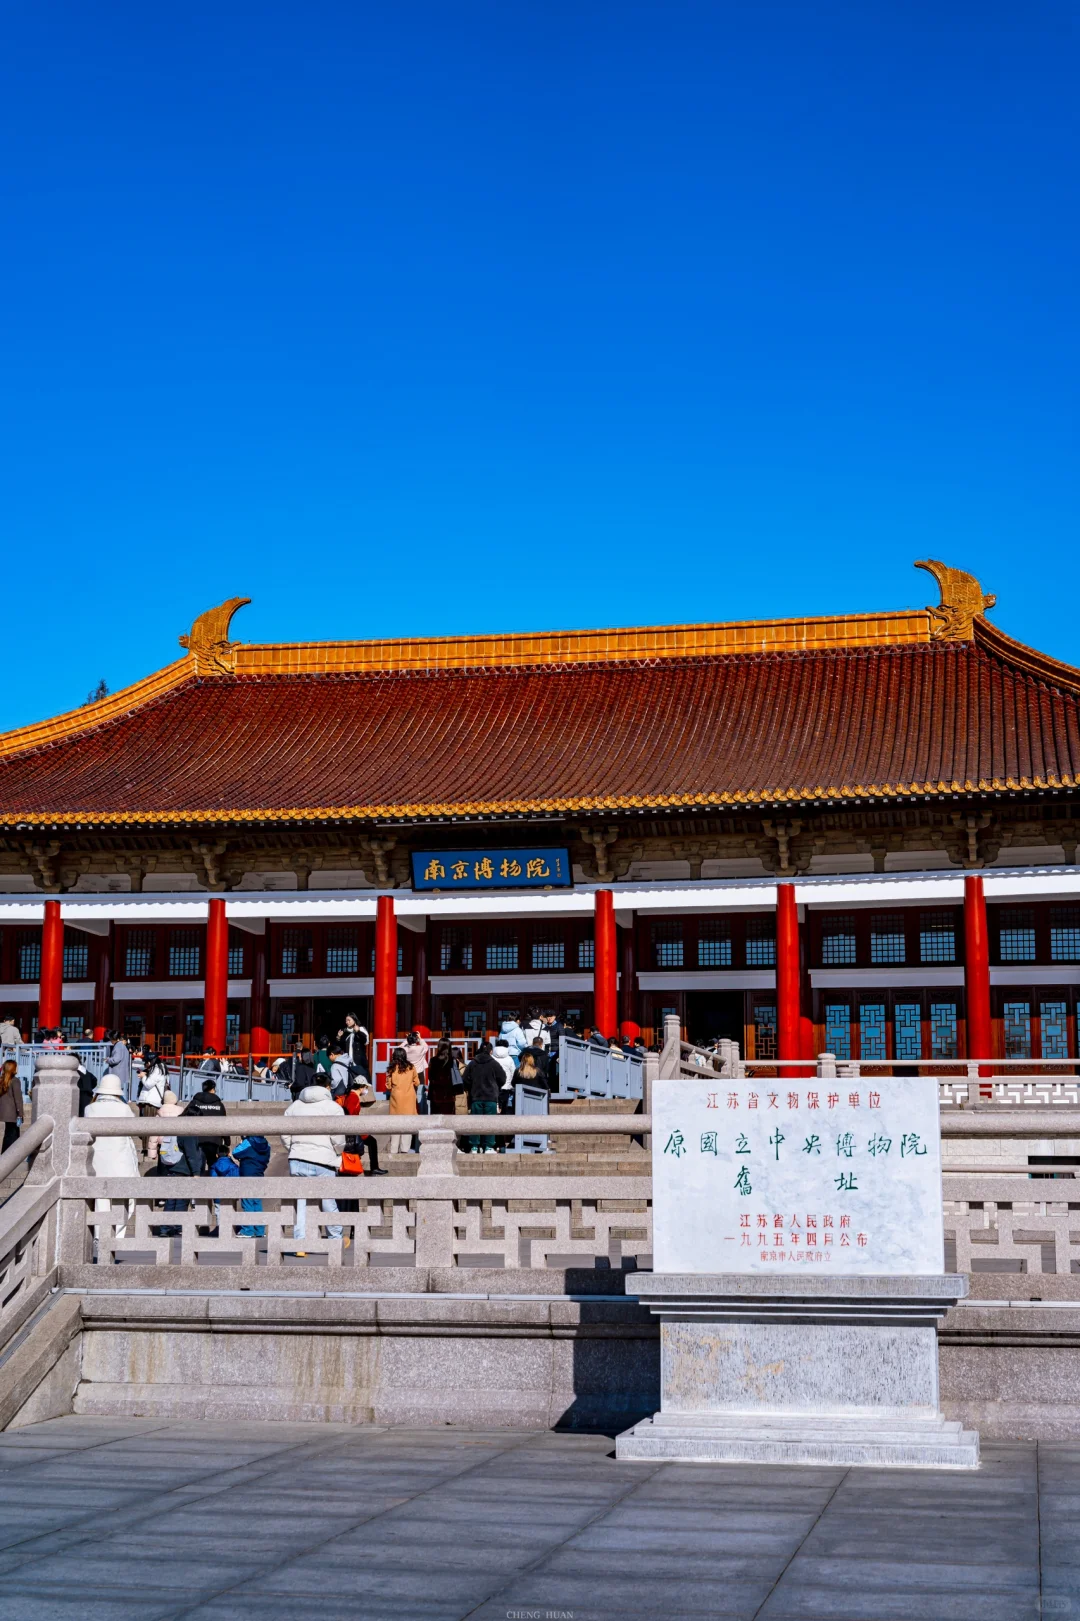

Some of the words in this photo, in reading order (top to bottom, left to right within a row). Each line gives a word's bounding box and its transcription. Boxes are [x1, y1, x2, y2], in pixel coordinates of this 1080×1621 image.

[423, 857, 550, 881] 南京博物院
[706, 1091, 882, 1109] 江苏省文物保护单位
[663, 1127, 928, 1160] 原國立中央博物院
[739, 1214, 852, 1228] 江苏省人民政府
[723, 1232, 869, 1247] 一九九五年四月公布
[760, 1250, 832, 1262] 南京市人民政府立
